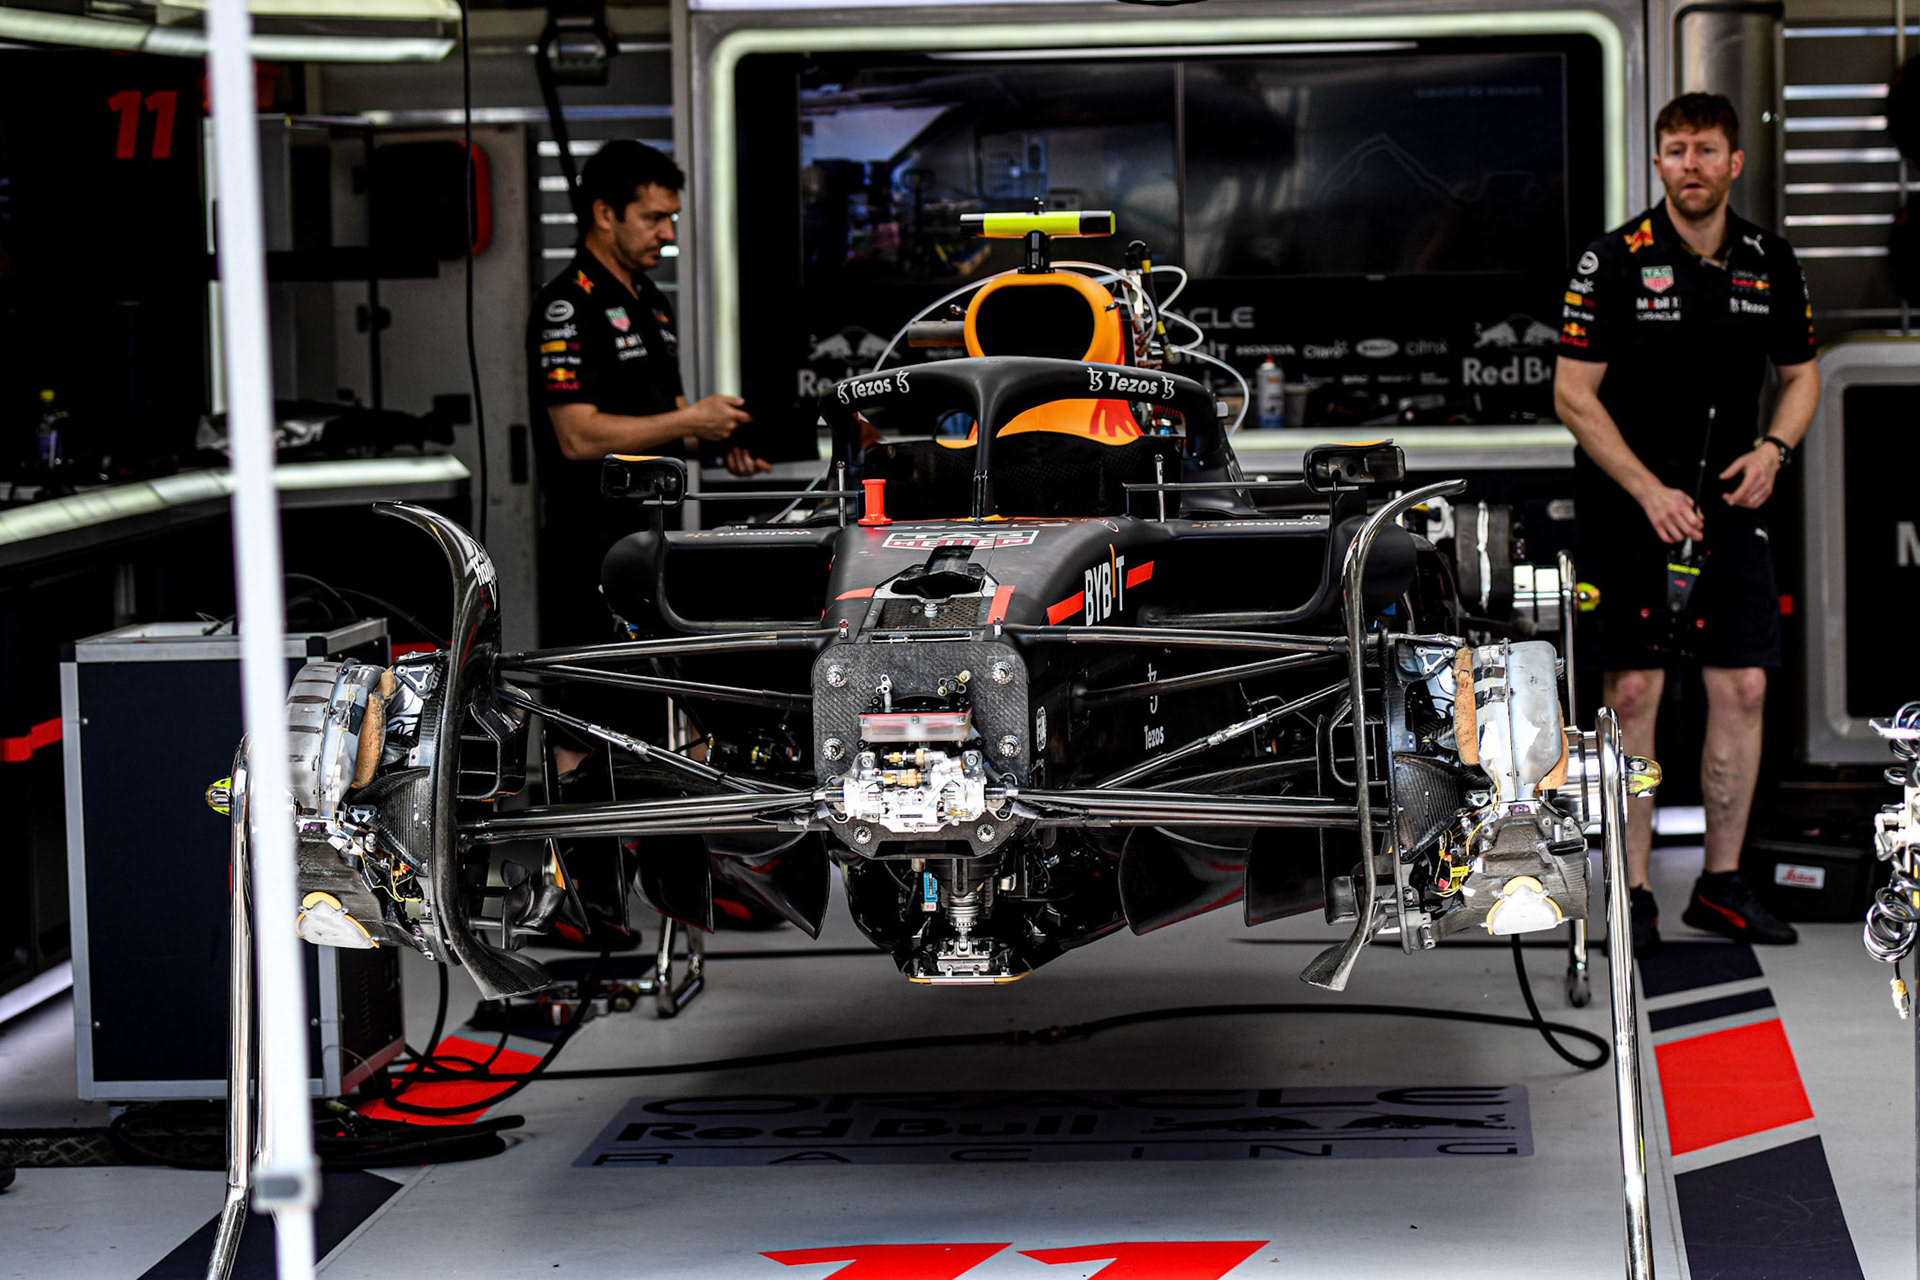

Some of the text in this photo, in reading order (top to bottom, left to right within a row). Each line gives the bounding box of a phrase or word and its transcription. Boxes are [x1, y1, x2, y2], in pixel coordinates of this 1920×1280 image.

[107, 90, 178, 160] 11
[1107, 371, 1158, 395] Tezos
[1463, 357, 1519, 386] Red
[851, 378, 892, 399] Tezos
[1085, 544, 1125, 627] BYBIT
[1143, 724, 1165, 750] Tezos
[642, 1085, 1510, 1116] ORACLE
[615, 1114, 1099, 1142] Red Bull
[592, 1142, 1518, 1167] RACING
